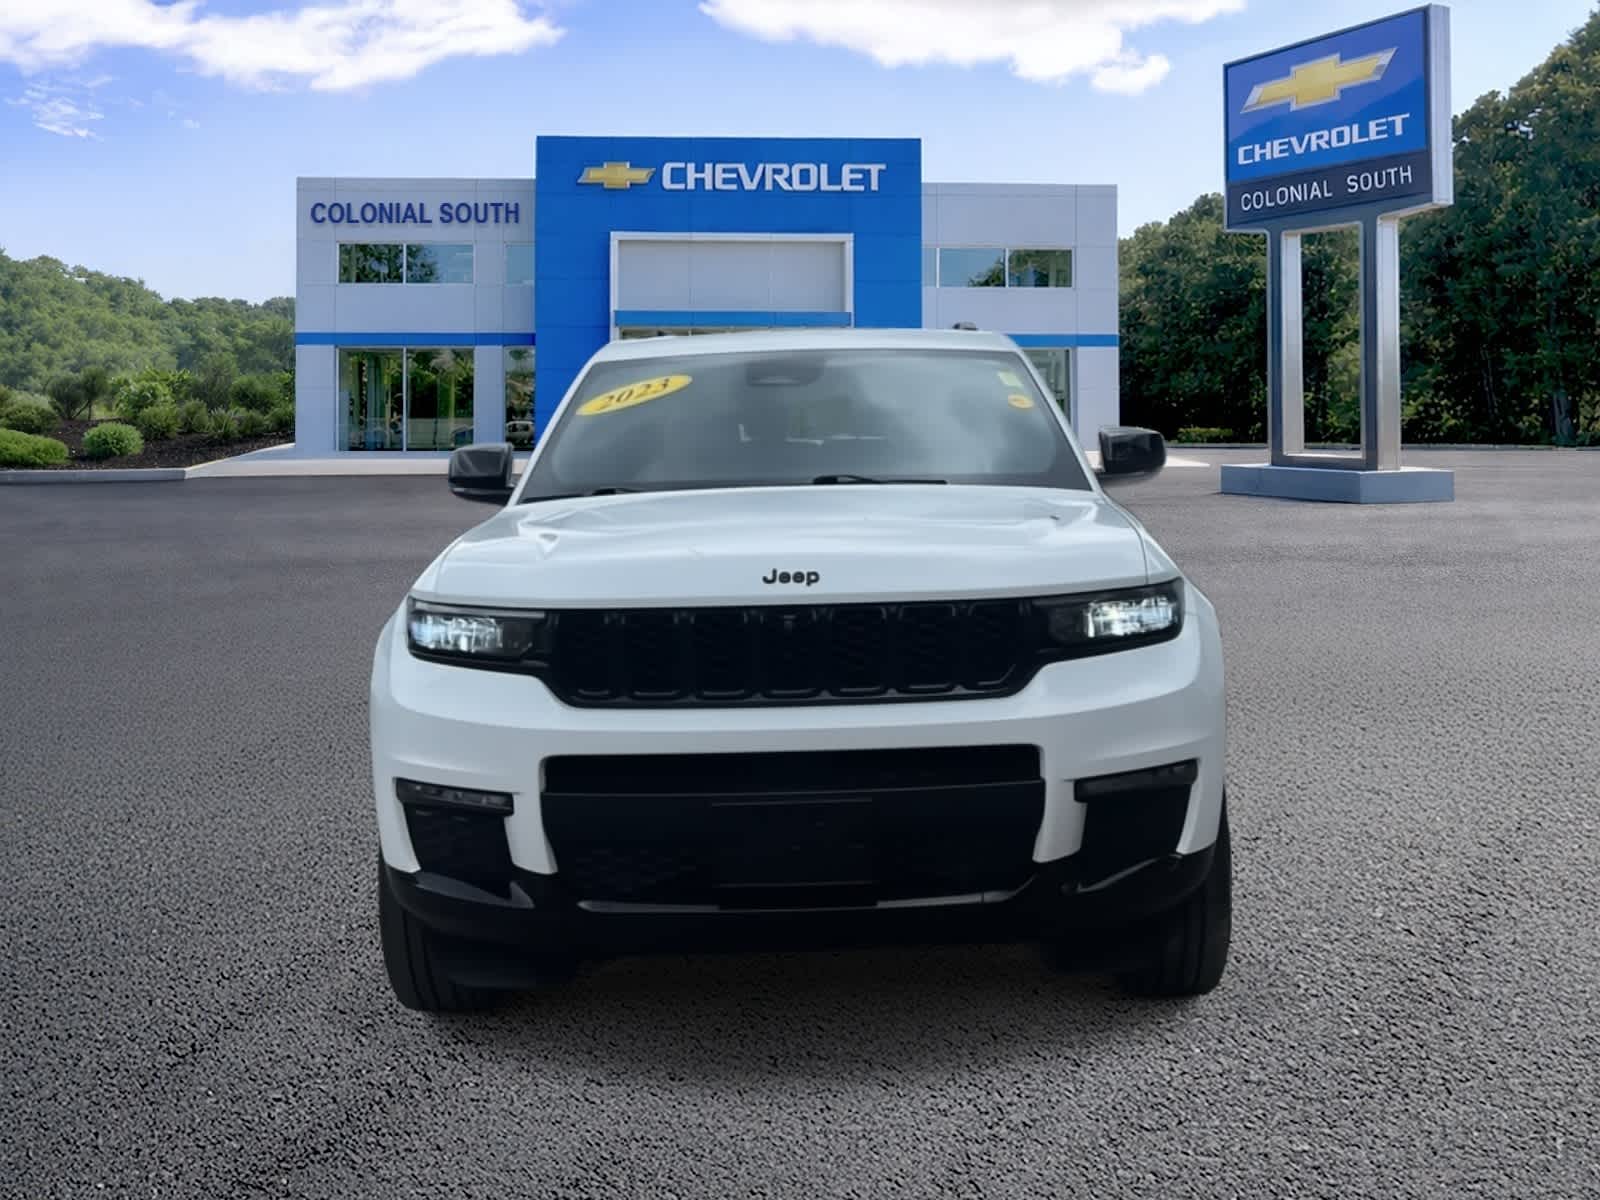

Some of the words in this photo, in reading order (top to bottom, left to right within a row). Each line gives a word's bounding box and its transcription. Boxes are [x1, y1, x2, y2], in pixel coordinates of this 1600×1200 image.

[1238, 113, 1410, 165] CHEVROLET
[661, 162, 886, 192] CHEVROLET
[1241, 180, 1333, 211] COLONIAL
[1347, 165, 1413, 193] SOUTH
[310, 202, 433, 225] COLONIAL
[439, 202, 521, 225] SOUTH
[595, 378, 670, 411] 2023
[762, 568, 820, 587] Jeep
